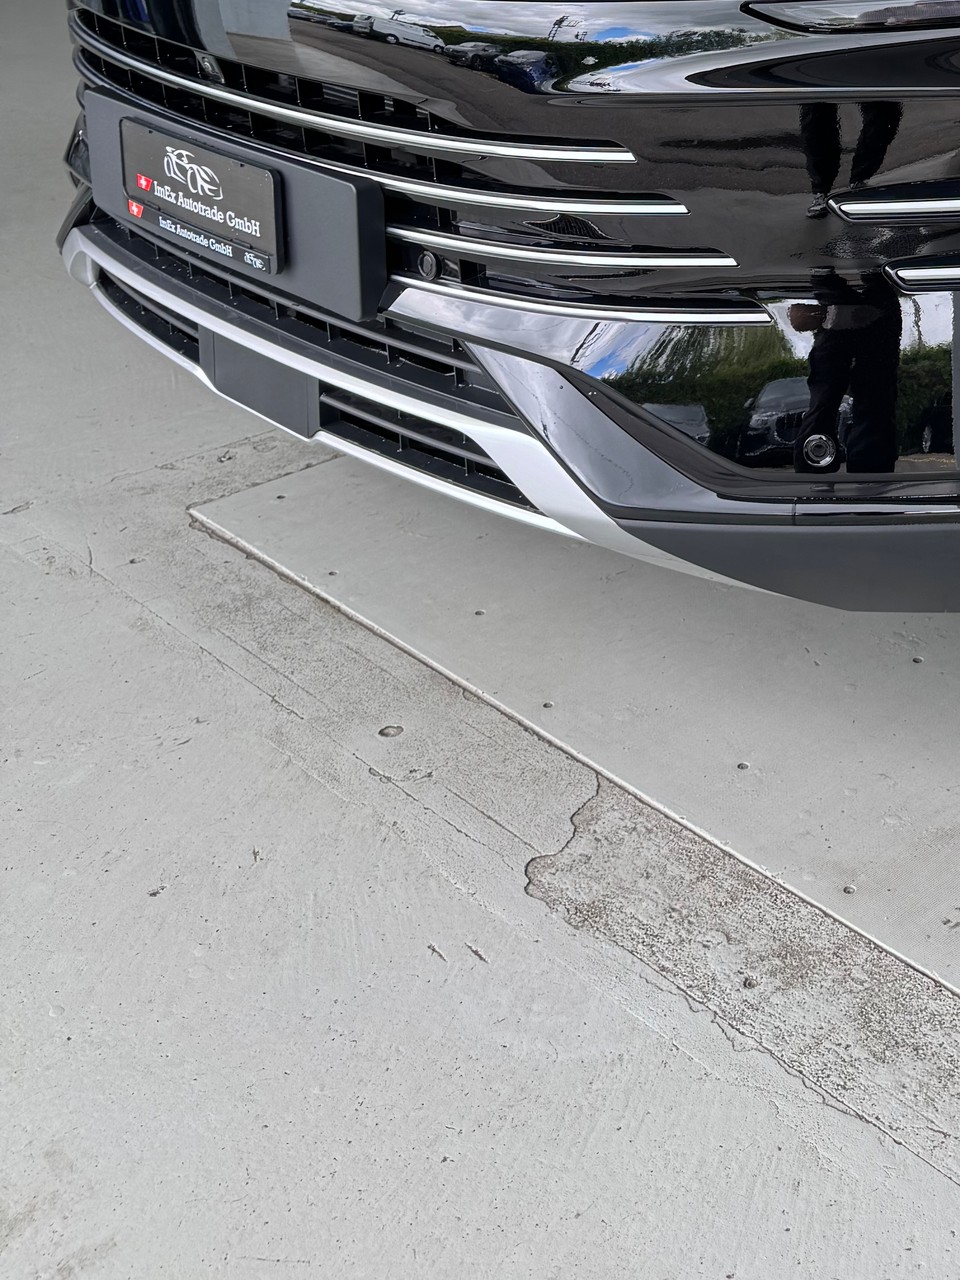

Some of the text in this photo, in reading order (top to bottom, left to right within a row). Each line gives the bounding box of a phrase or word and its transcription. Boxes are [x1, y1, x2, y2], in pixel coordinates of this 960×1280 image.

[153, 180, 261, 238] ImEx Autotrade GmbH
[158, 216, 233, 258] ImEx Autotrade GmbH
